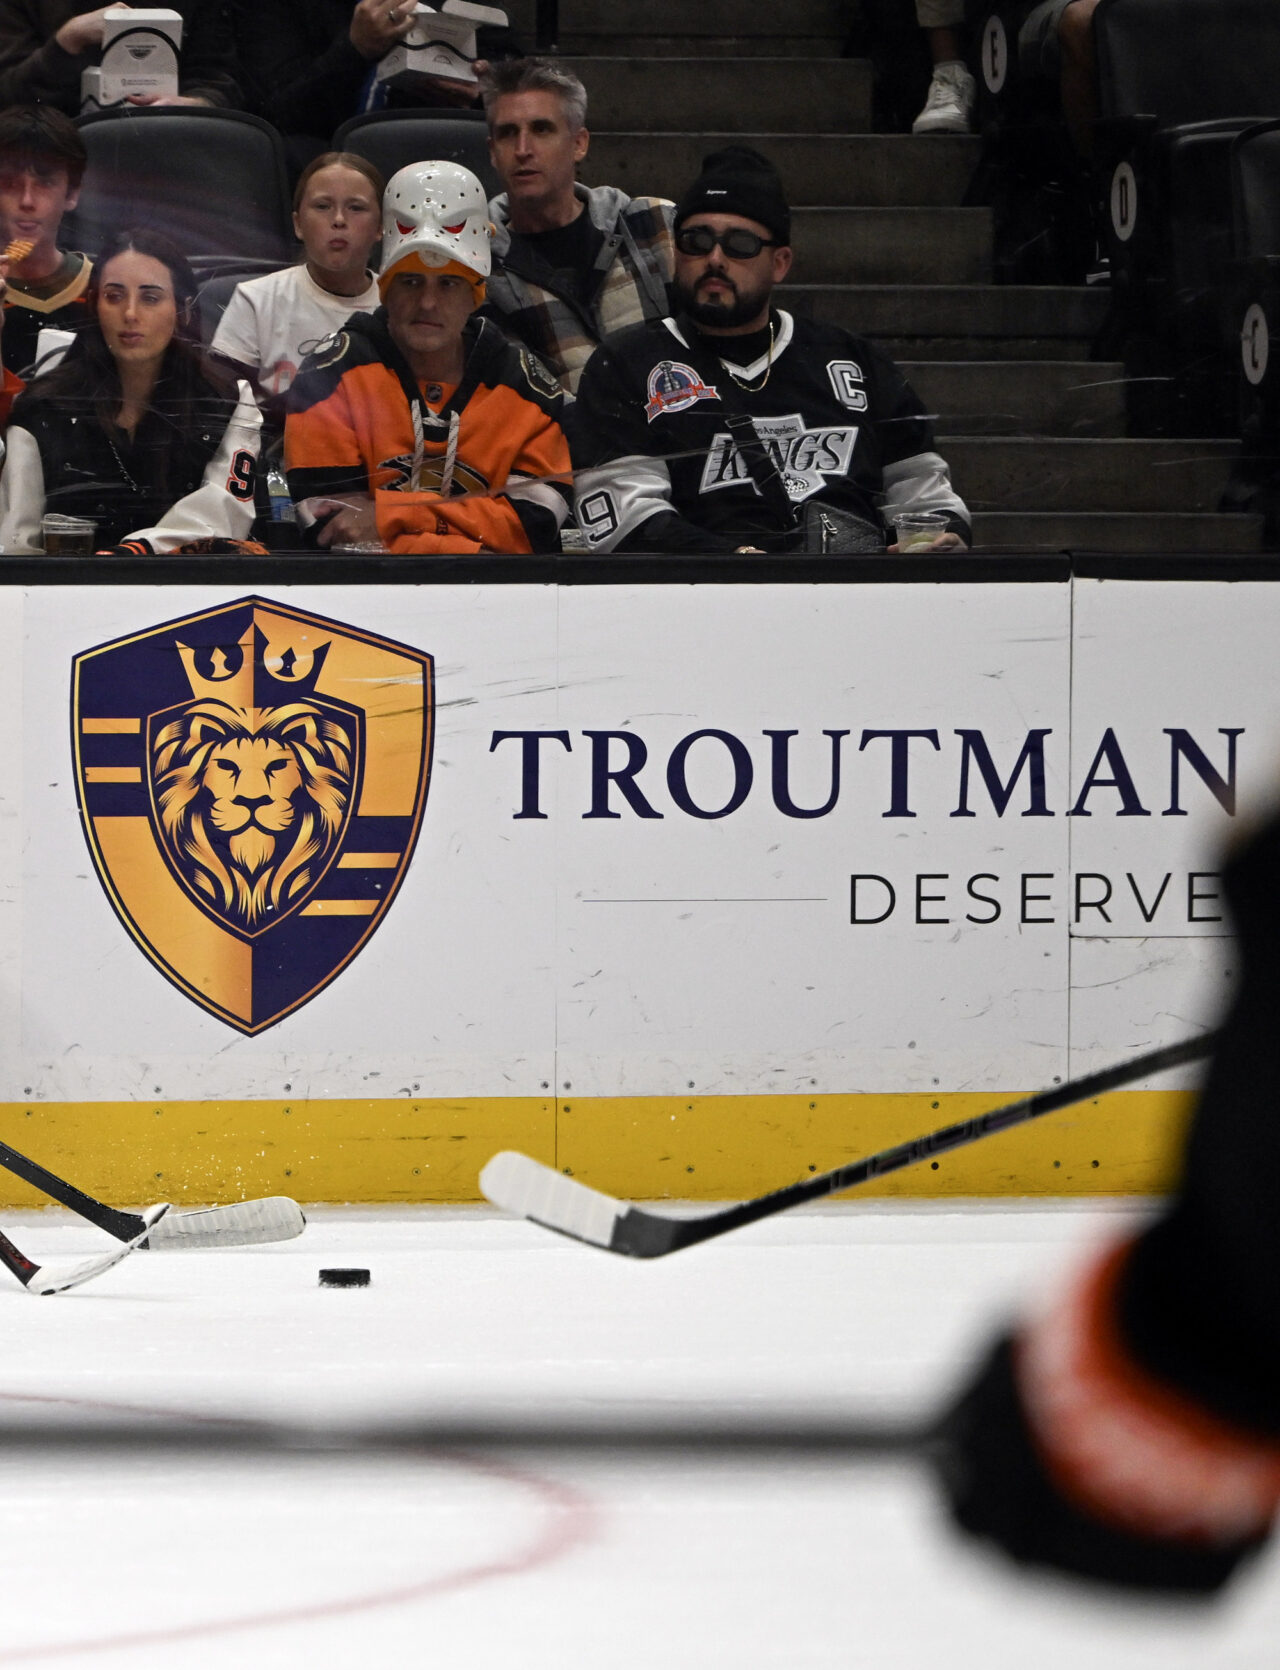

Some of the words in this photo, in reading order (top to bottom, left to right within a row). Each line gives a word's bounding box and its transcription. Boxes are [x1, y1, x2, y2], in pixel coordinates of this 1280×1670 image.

[826, 360, 869, 412] C
[711, 432, 847, 485] KNGS
[489, 727, 1245, 820] TROUTMAN
[849, 872, 1223, 926] DESERVE
